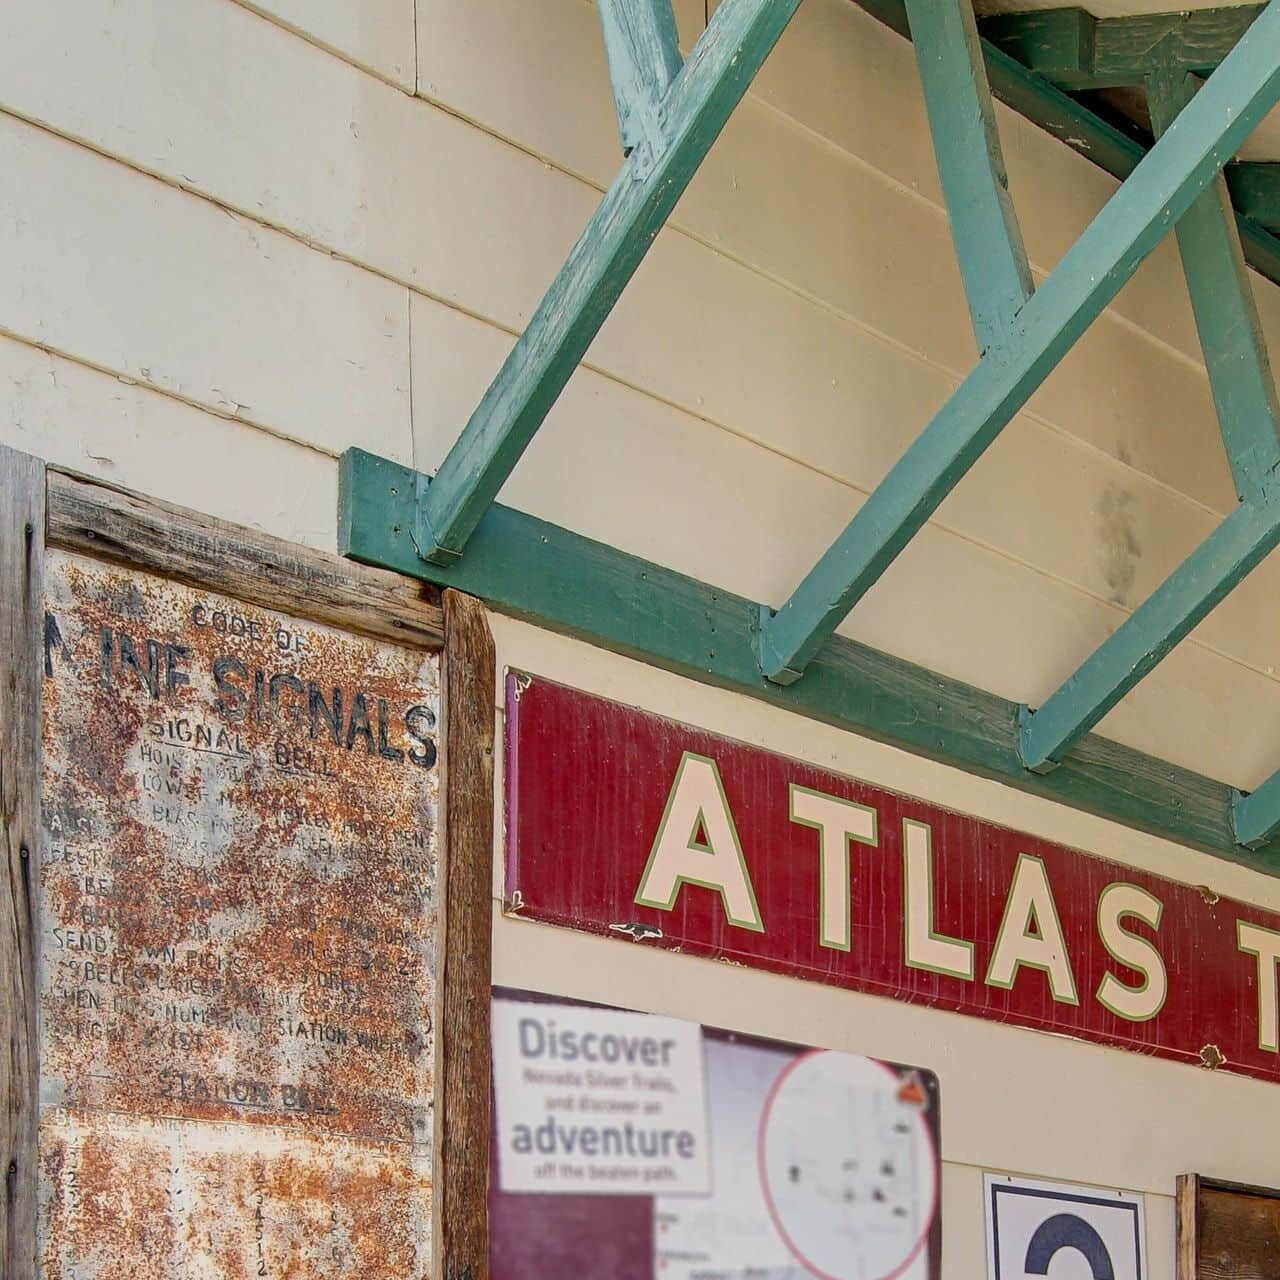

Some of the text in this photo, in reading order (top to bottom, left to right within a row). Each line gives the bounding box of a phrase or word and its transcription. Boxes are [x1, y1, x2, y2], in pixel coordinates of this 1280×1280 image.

[151, 716, 251, 756] SIGNAL
[212, 655, 437, 770] SIGNALS
[633, 751, 1169, 1024] ATLAS
[518, 1018, 676, 1068] Discover
[510, 1117, 697, 1159] adventure
